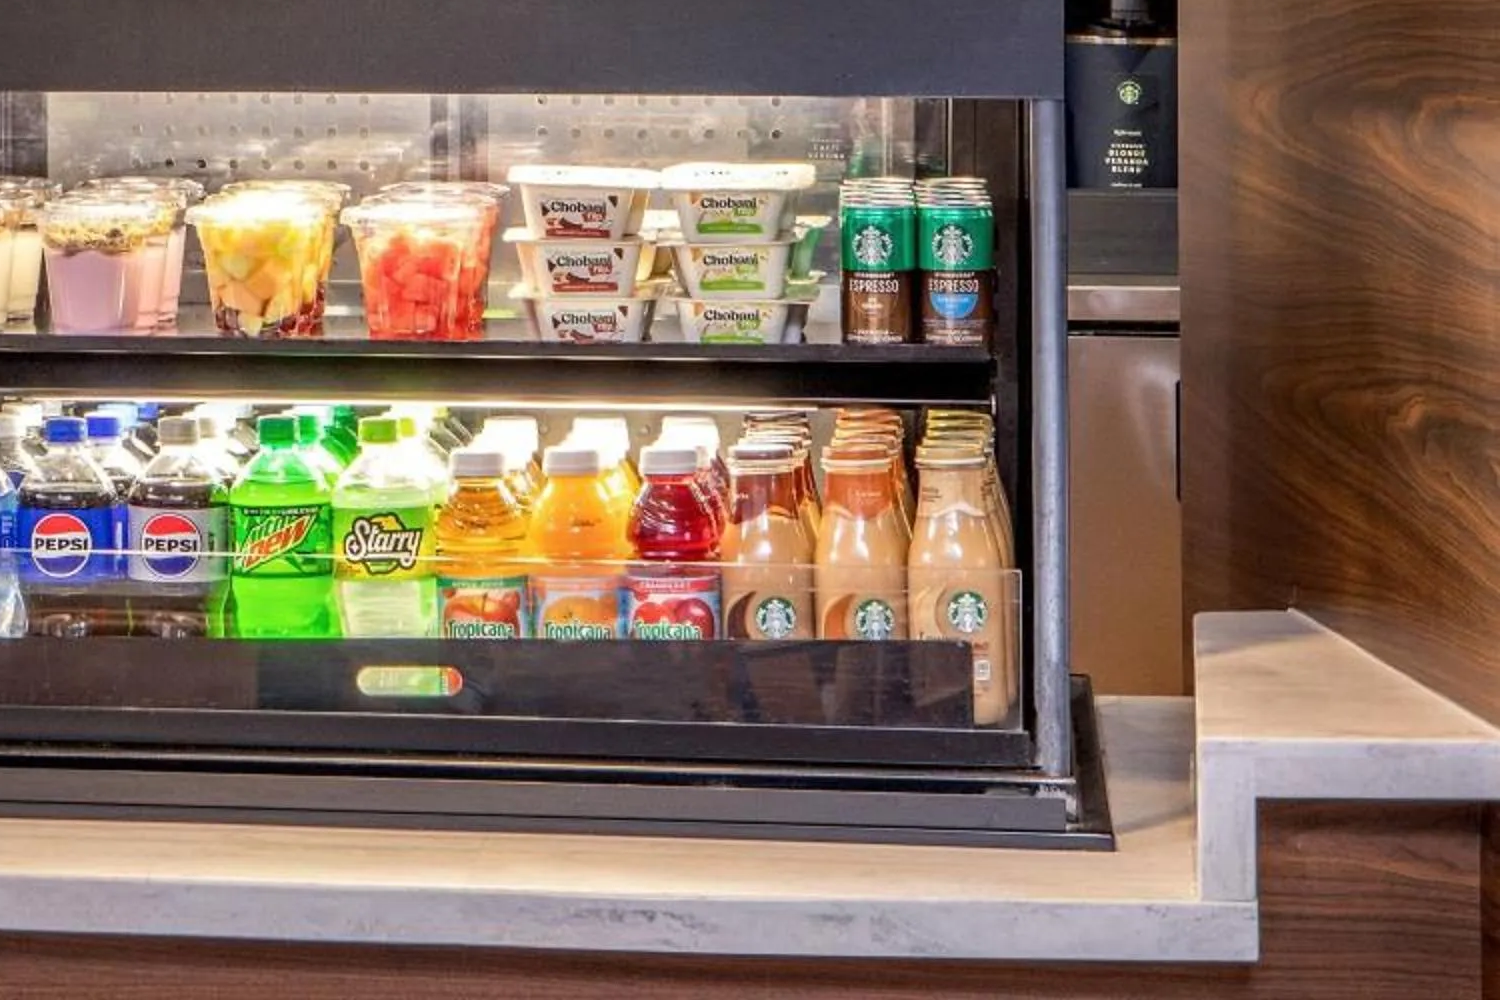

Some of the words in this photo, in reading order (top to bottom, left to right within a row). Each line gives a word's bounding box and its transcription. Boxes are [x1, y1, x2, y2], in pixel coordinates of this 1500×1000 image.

[551, 202, 606, 214] Chobani
[701, 198, 756, 209] Chobani
[556, 255, 612, 268] Chobani
[703, 253, 758, 266] Chobani
[849, 279, 899, 293] ESPRESSO
[928, 278, 979, 293] ESPRESSO
[561, 312, 616, 325] Chobani
[704, 309, 760, 322] Chobani
[34, 537, 88, 551] PEPSI
[144, 537, 197, 552] PEPSI
[346, 517, 422, 567] Starry
[448, 620, 514, 639] Tropicana
